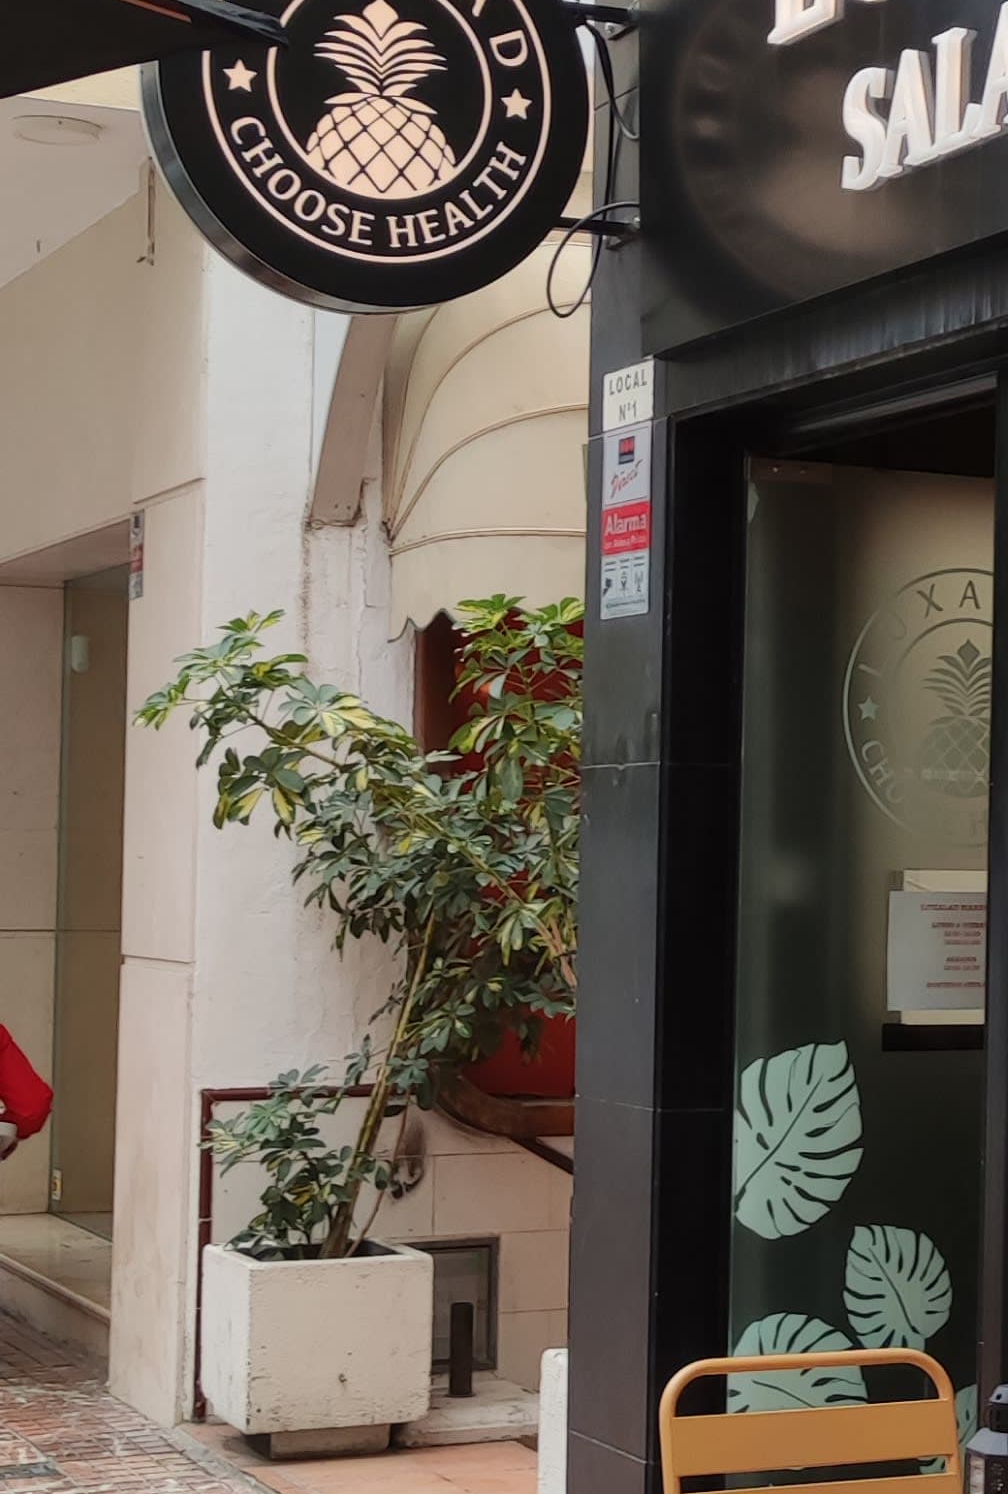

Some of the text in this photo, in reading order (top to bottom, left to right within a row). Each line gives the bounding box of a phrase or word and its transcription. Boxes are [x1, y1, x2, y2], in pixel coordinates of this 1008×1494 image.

[230, 115, 528, 249] CHOOSE HEALTH
[609, 369, 648, 396] LOCAL
[603, 513, 647, 537] Alarma
